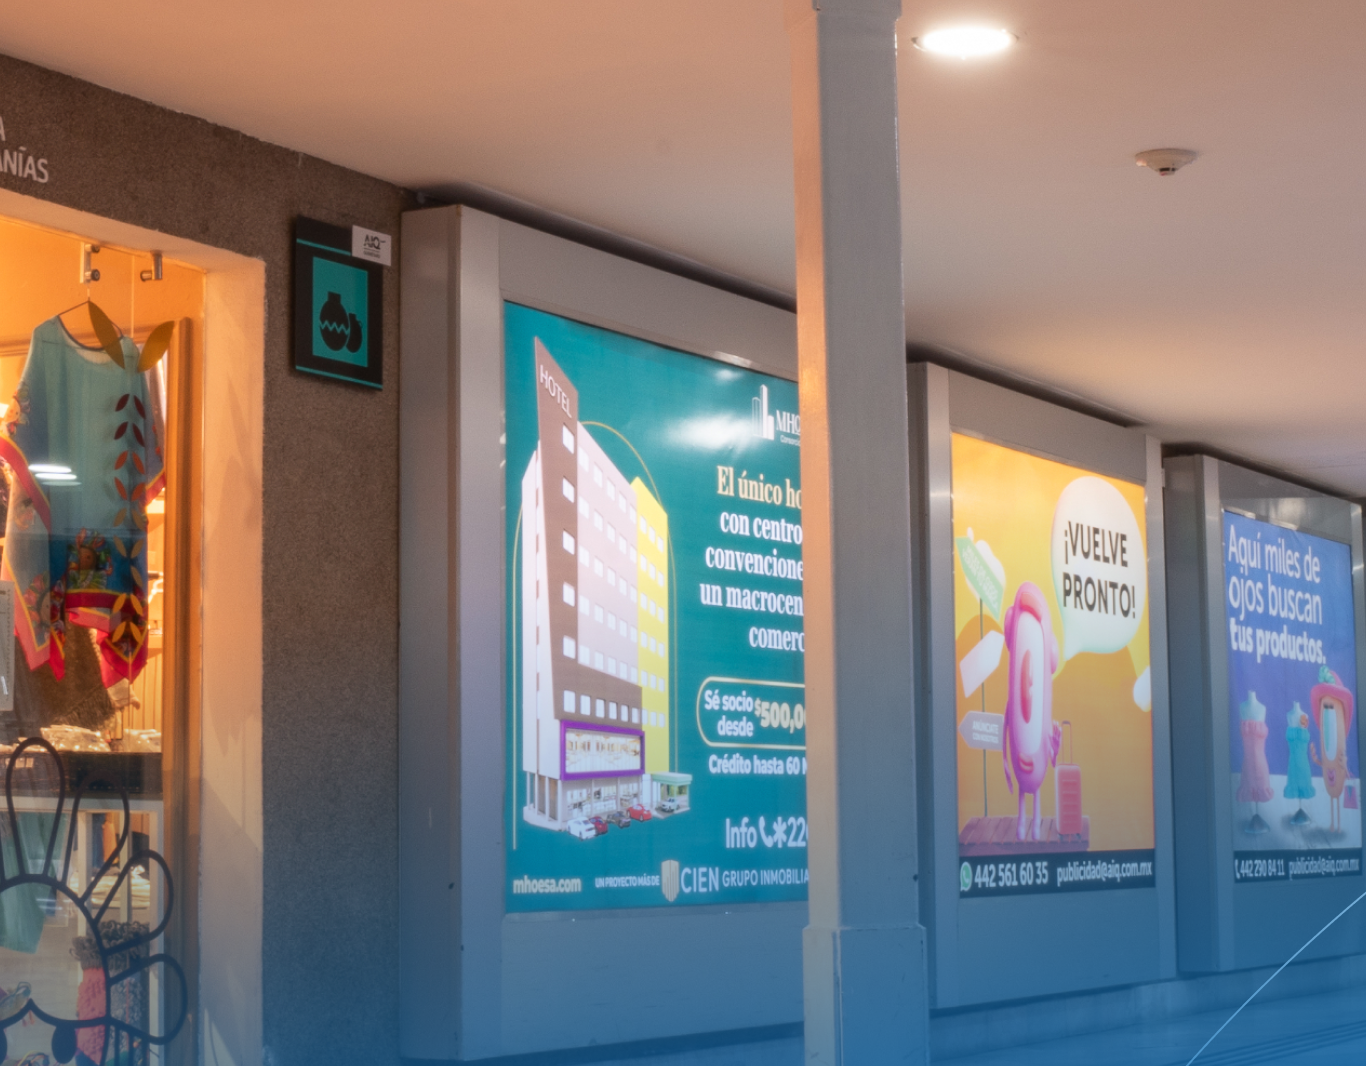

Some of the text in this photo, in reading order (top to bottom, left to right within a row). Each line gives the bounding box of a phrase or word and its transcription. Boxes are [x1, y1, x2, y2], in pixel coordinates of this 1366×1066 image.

[540, 364, 572, 418] HOTEL
[717, 465, 734, 496] El
[738, 470, 782, 505] único
[720, 511, 803, 545] con centro
[1064, 520, 1128, 567] ¡VUELVE
[705, 546, 803, 581] convencione
[1228, 524, 1321, 584] Aquí miles de
[700, 583, 804, 616] un macrocen
[1063, 572, 1135, 619] PRONTO!
[1228, 567, 1323, 625] ojos buscan
[749, 626, 805, 652] comerc
[1229, 617, 1326, 664] tus productos.
[704, 689, 754, 712] Sé socio
[754, 698, 806, 734] $500,0
[717, 715, 754, 737] desde
[708, 753, 752, 774] Crédito
[753, 755, 784, 774] hasta
[786, 756, 800, 775] 60
[725, 816, 757, 848] Info
[513, 875, 581, 894] mhoesa.com
[595, 877, 605, 888] UN
[605, 875, 636, 888] PROYECTO
[681, 867, 809, 892] CIEN GRUPO INMOBILIA
[974, 860, 1152, 888] 442 561 60 35 publicidad@aiq.com.mx
[1240, 859, 1253, 877] 442
